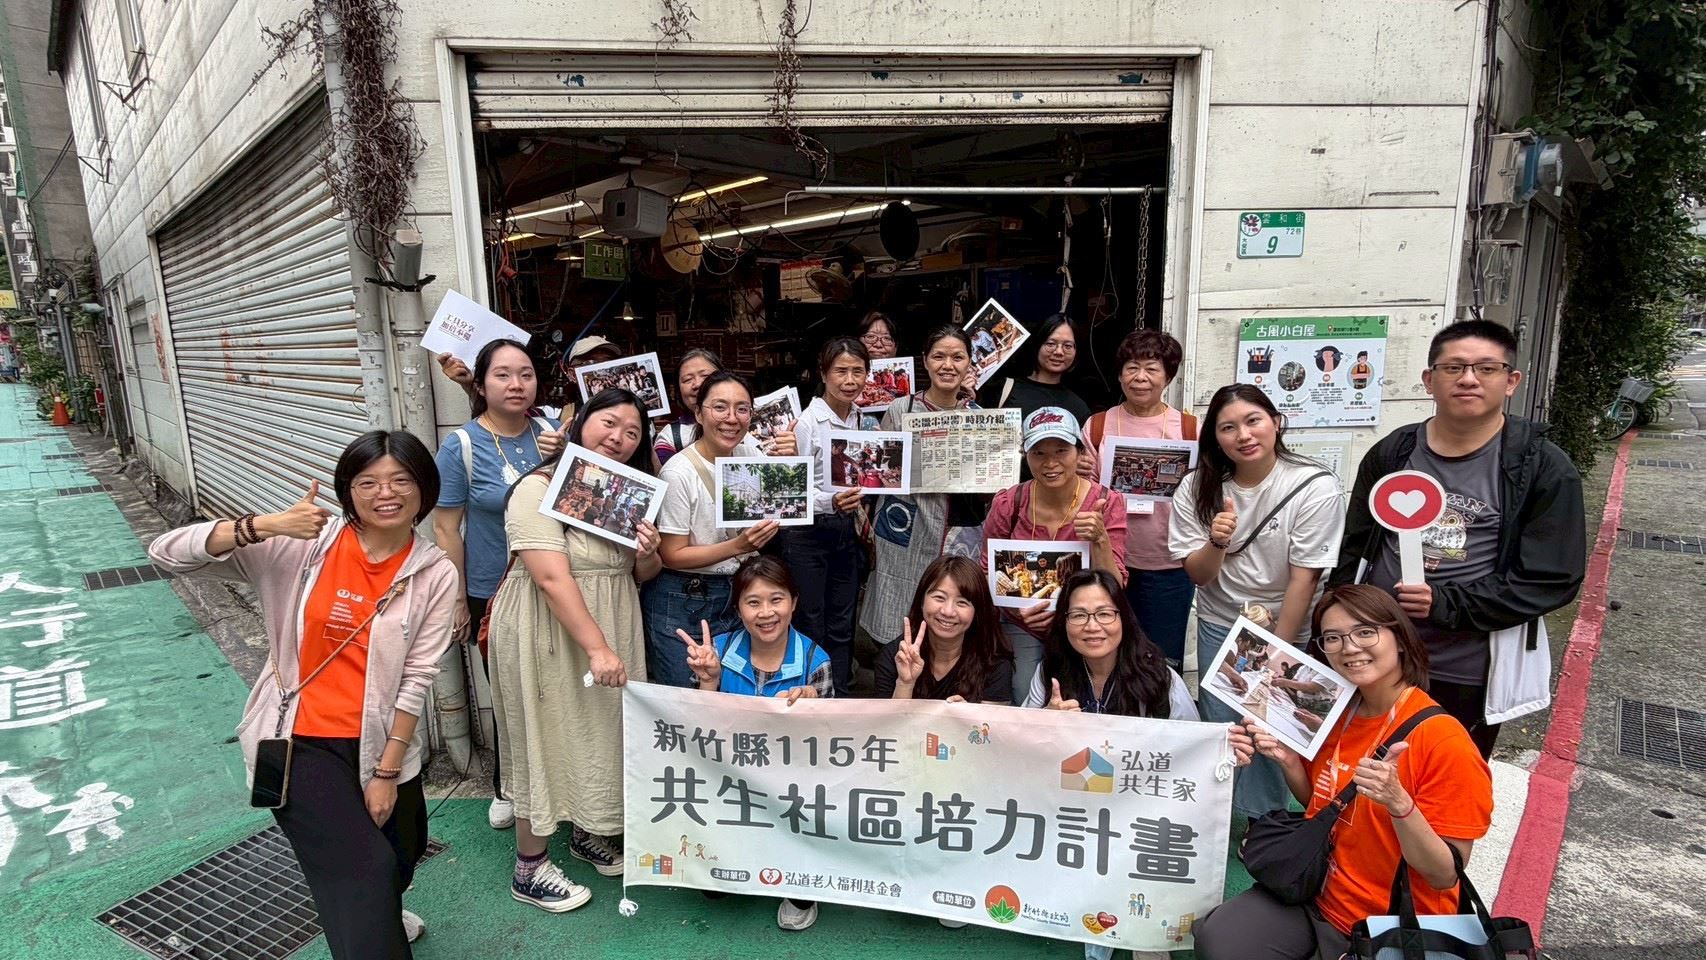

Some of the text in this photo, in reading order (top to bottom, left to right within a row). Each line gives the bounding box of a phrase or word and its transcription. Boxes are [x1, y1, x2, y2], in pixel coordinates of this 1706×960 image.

[1267, 236, 1279, 254] 9
[1256, 324, 1316, 338] 古風小白屋
[653, 718, 900, 772] 新竹縣115年
[1121, 750, 1172, 773] 弘道
[1118, 774, 1197, 803] 共生家
[650, 765, 1199, 884] 共生社區培力計畫
[714, 869, 748, 881] 主辦單位
[785, 871, 902, 898] 弘道老人福利基金會
[935, 891, 973, 908] 補助單位
